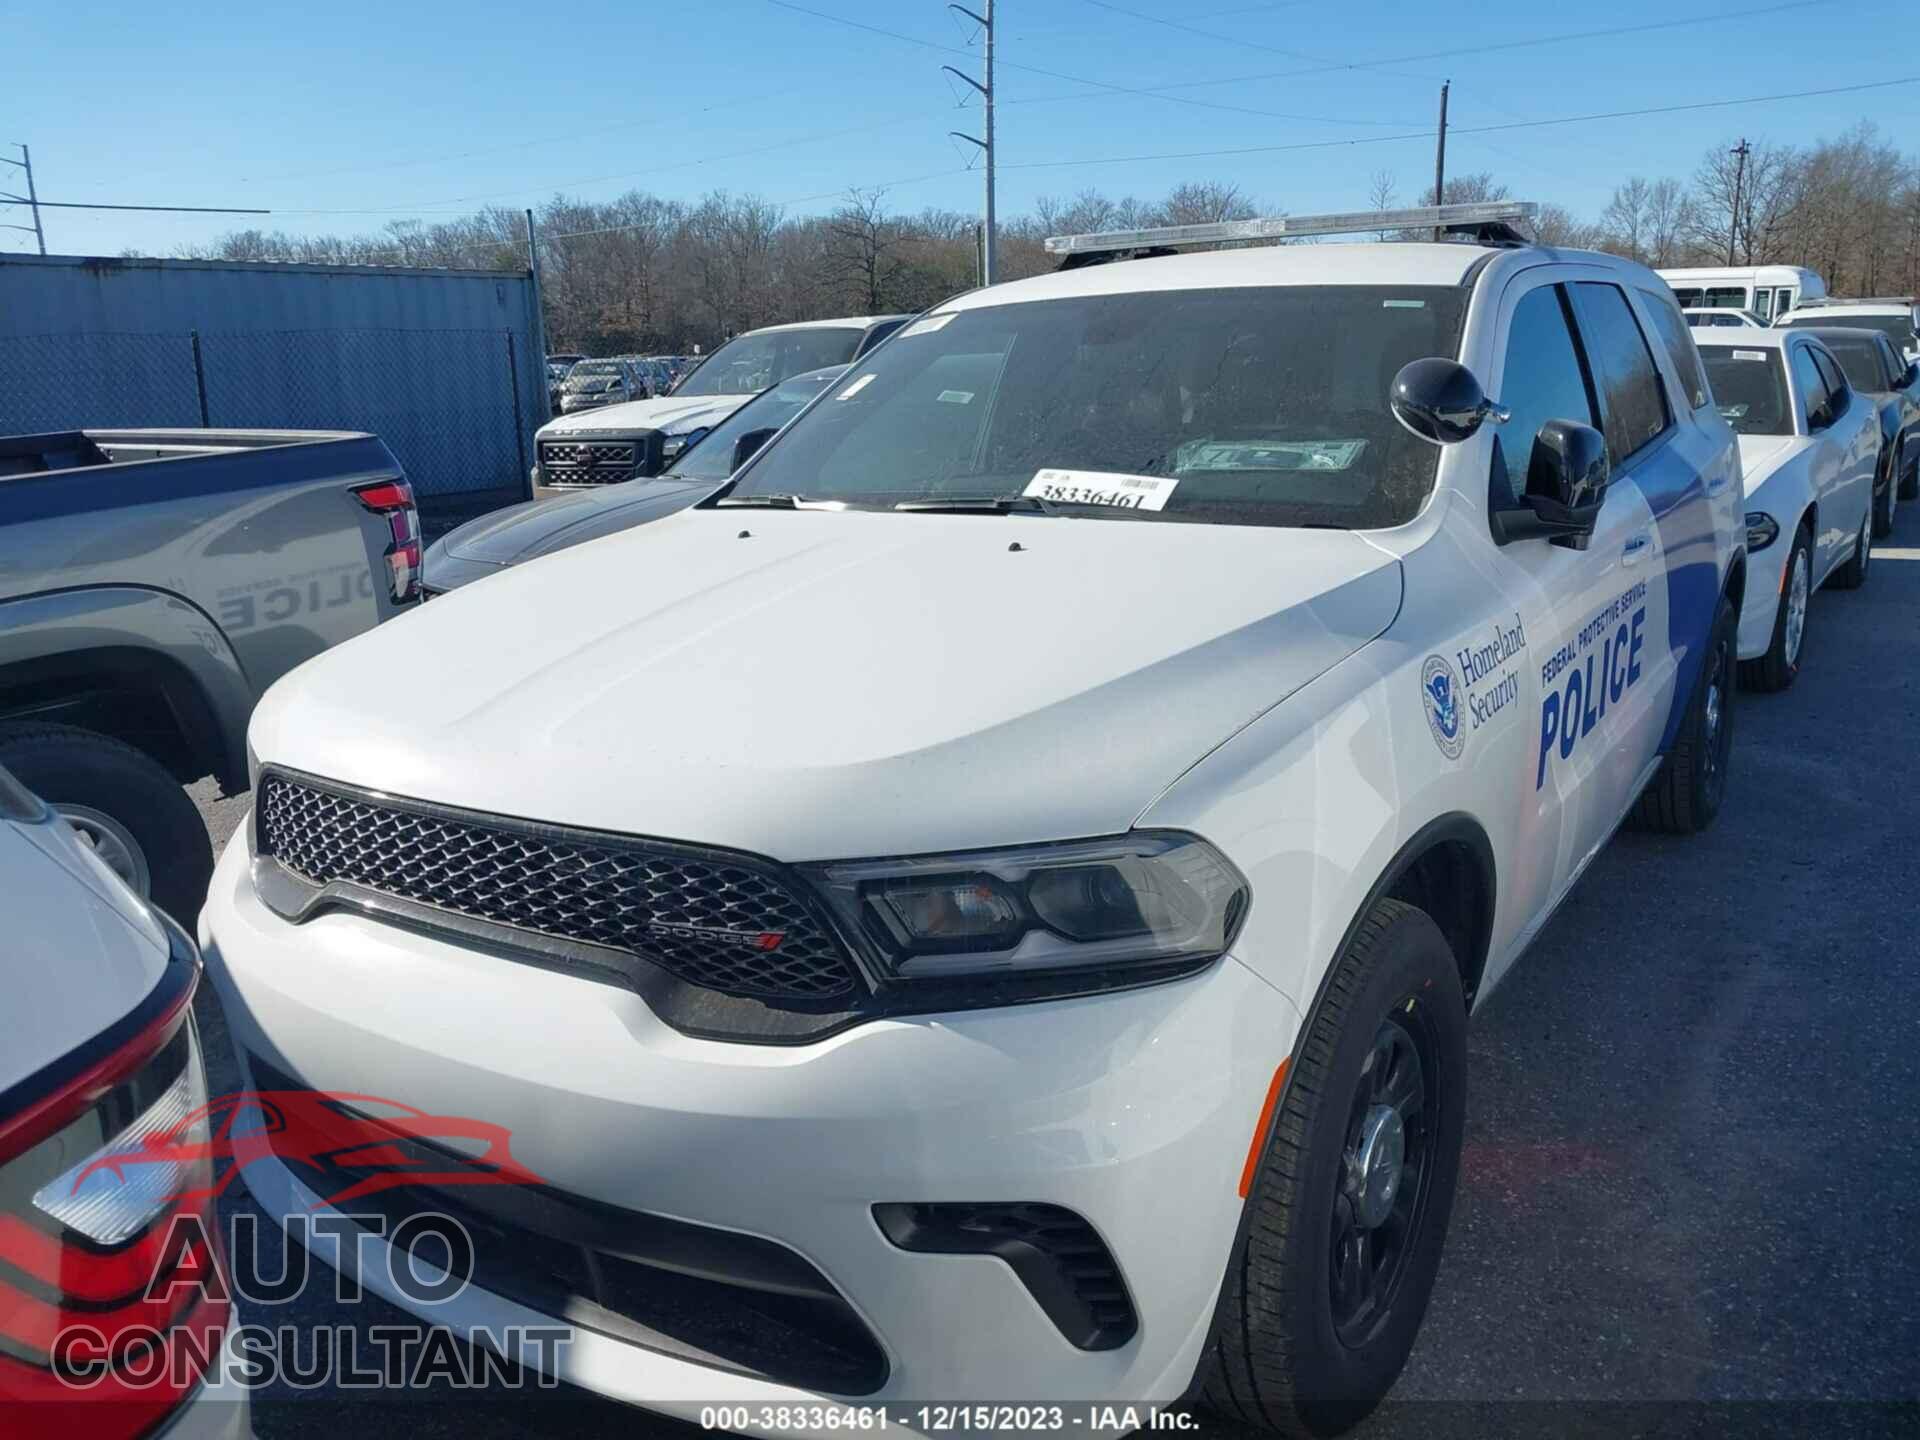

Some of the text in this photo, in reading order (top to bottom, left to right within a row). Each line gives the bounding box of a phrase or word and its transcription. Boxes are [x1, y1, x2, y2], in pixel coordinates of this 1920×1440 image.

[1044, 485, 1144, 508] 38336461
[1456, 613, 1526, 687] Homeland
[1542, 578, 1646, 688] FEDERAL PROTECTIVE SERVICE
[1469, 669, 1519, 729] Security
[1537, 606, 1645, 791] POLICE
[651, 925, 764, 946] DODGE
